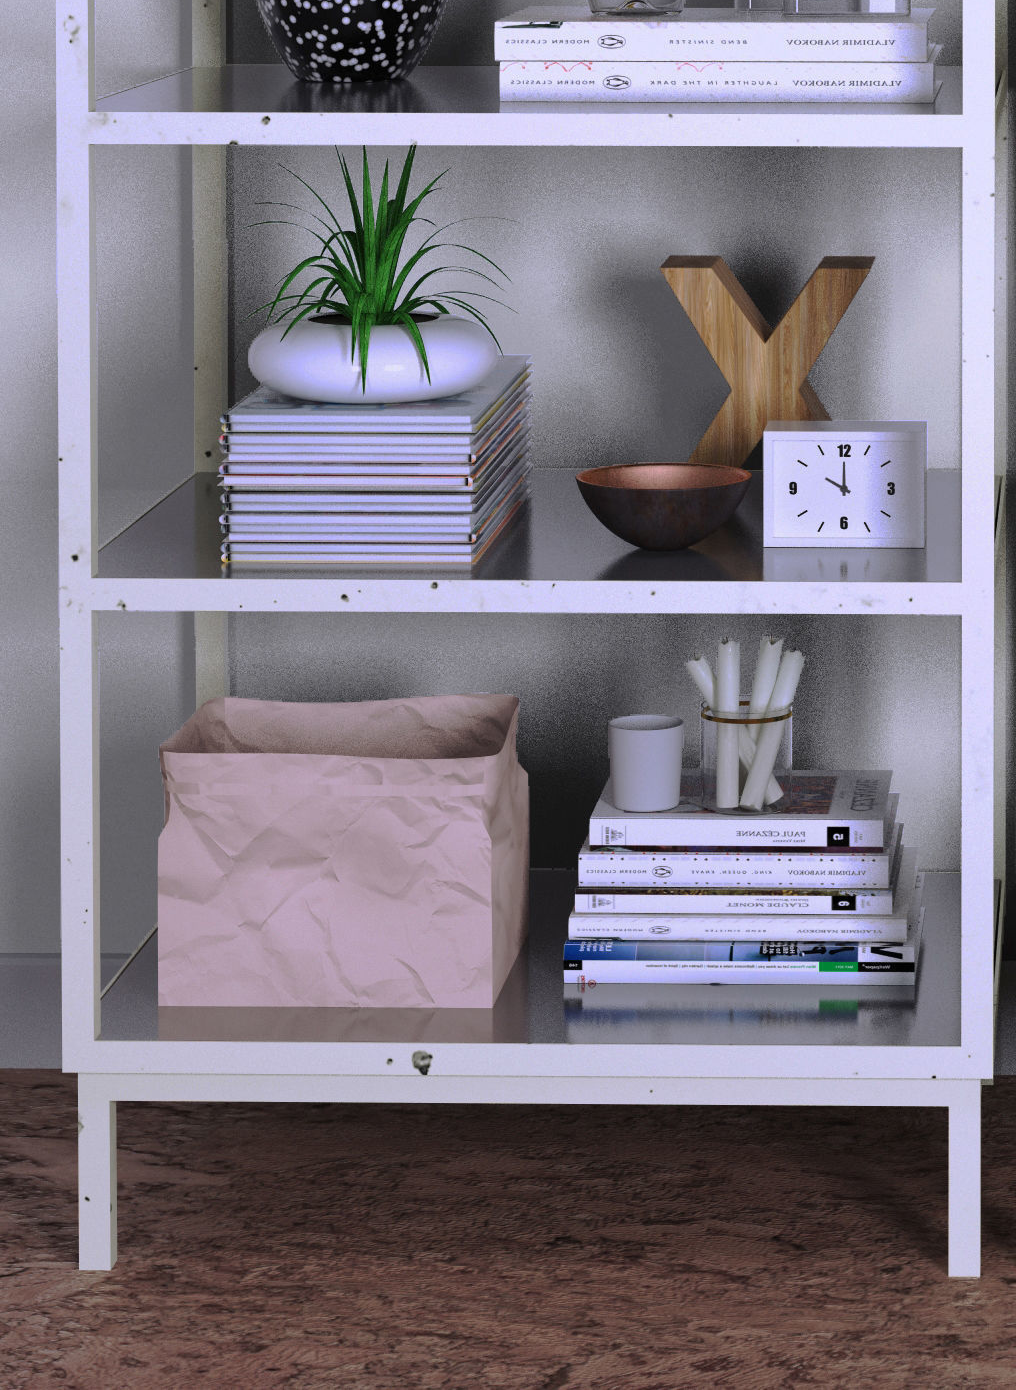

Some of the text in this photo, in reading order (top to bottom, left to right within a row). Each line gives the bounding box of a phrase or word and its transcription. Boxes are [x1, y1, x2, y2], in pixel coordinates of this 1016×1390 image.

[837, 444, 851, 457] 12
[789, 482, 797, 495] 9
[887, 482, 895, 495] 3
[840, 516, 848, 530] 6
